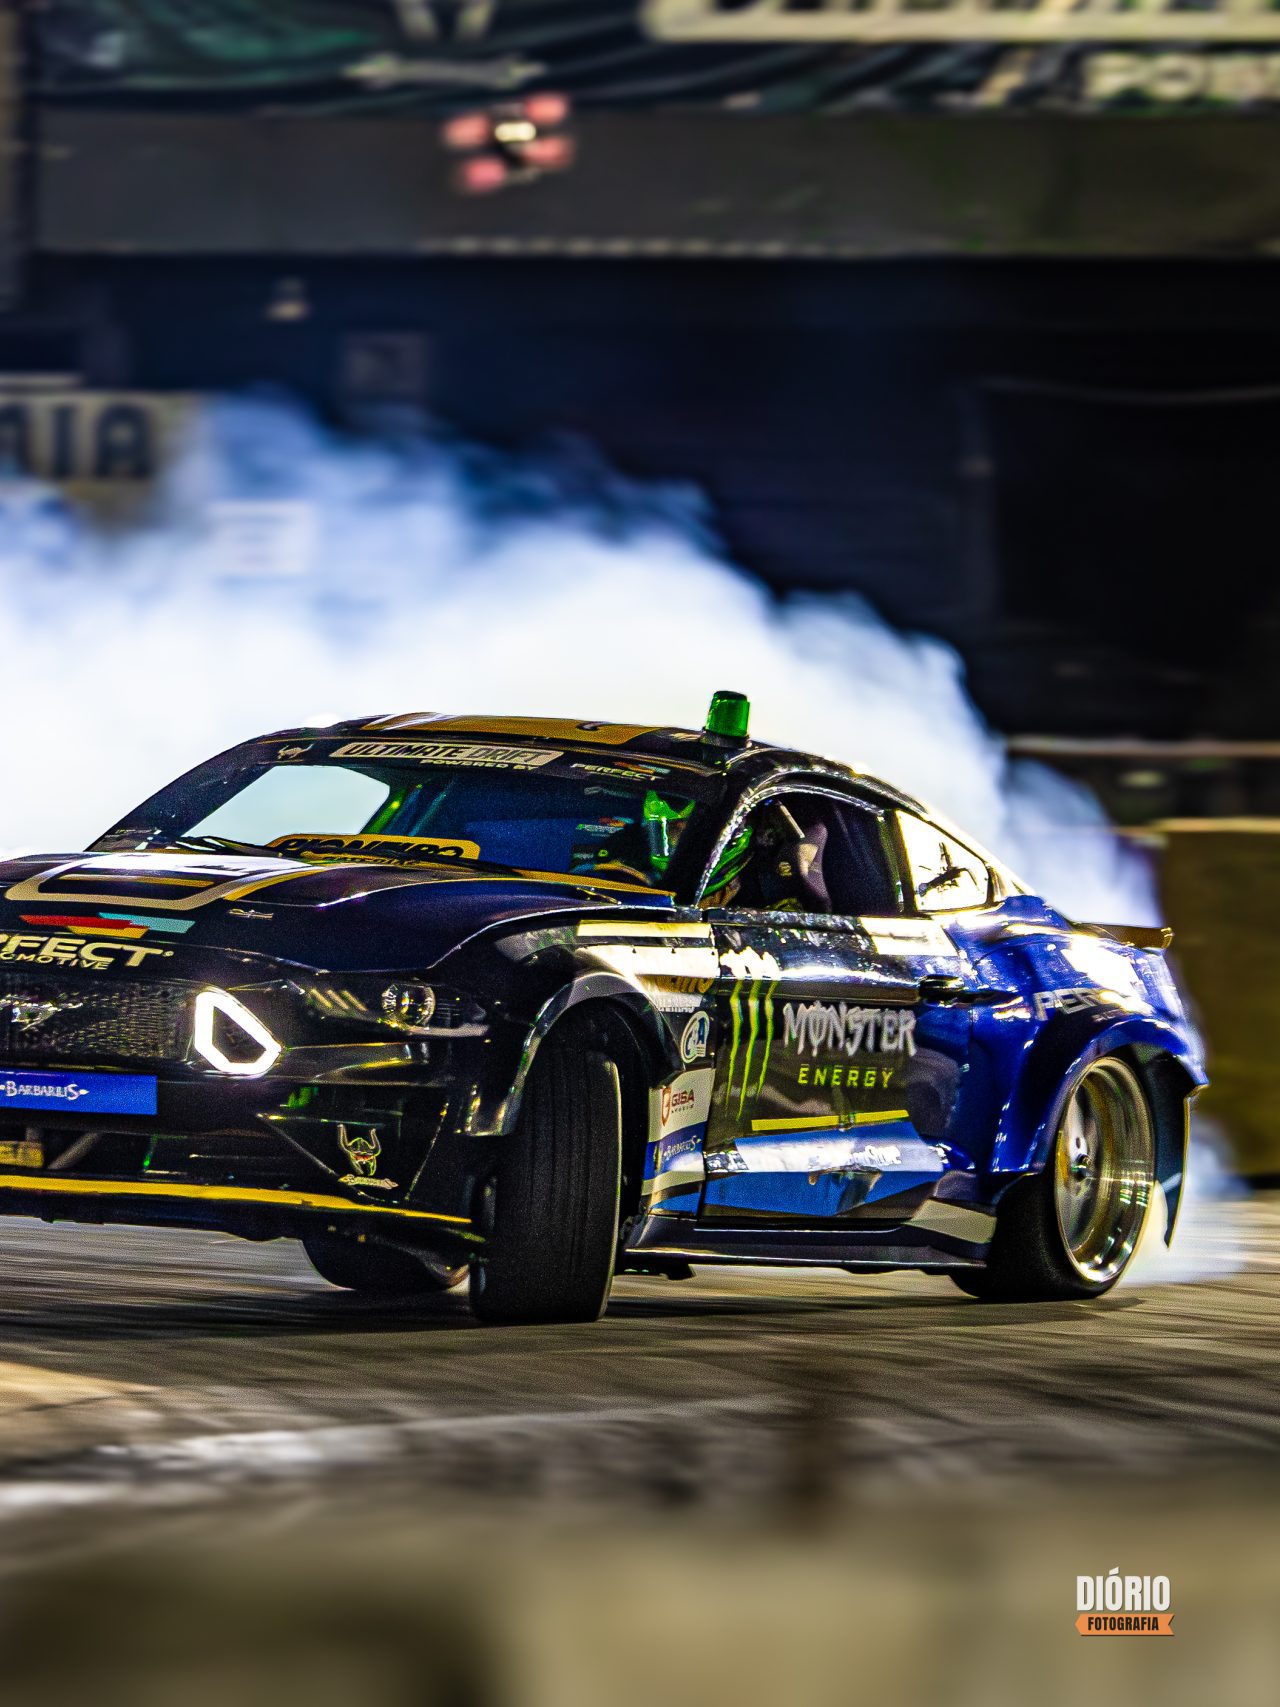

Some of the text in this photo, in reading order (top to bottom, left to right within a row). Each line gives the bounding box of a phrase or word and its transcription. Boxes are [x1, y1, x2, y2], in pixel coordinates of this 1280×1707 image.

[345, 743, 544, 763] ULTIMATE DRIFT
[420, 758, 509, 769] POWERED
[782, 1000, 918, 1057] MONSTER
[797, 1063, 894, 1088] ENERGY
